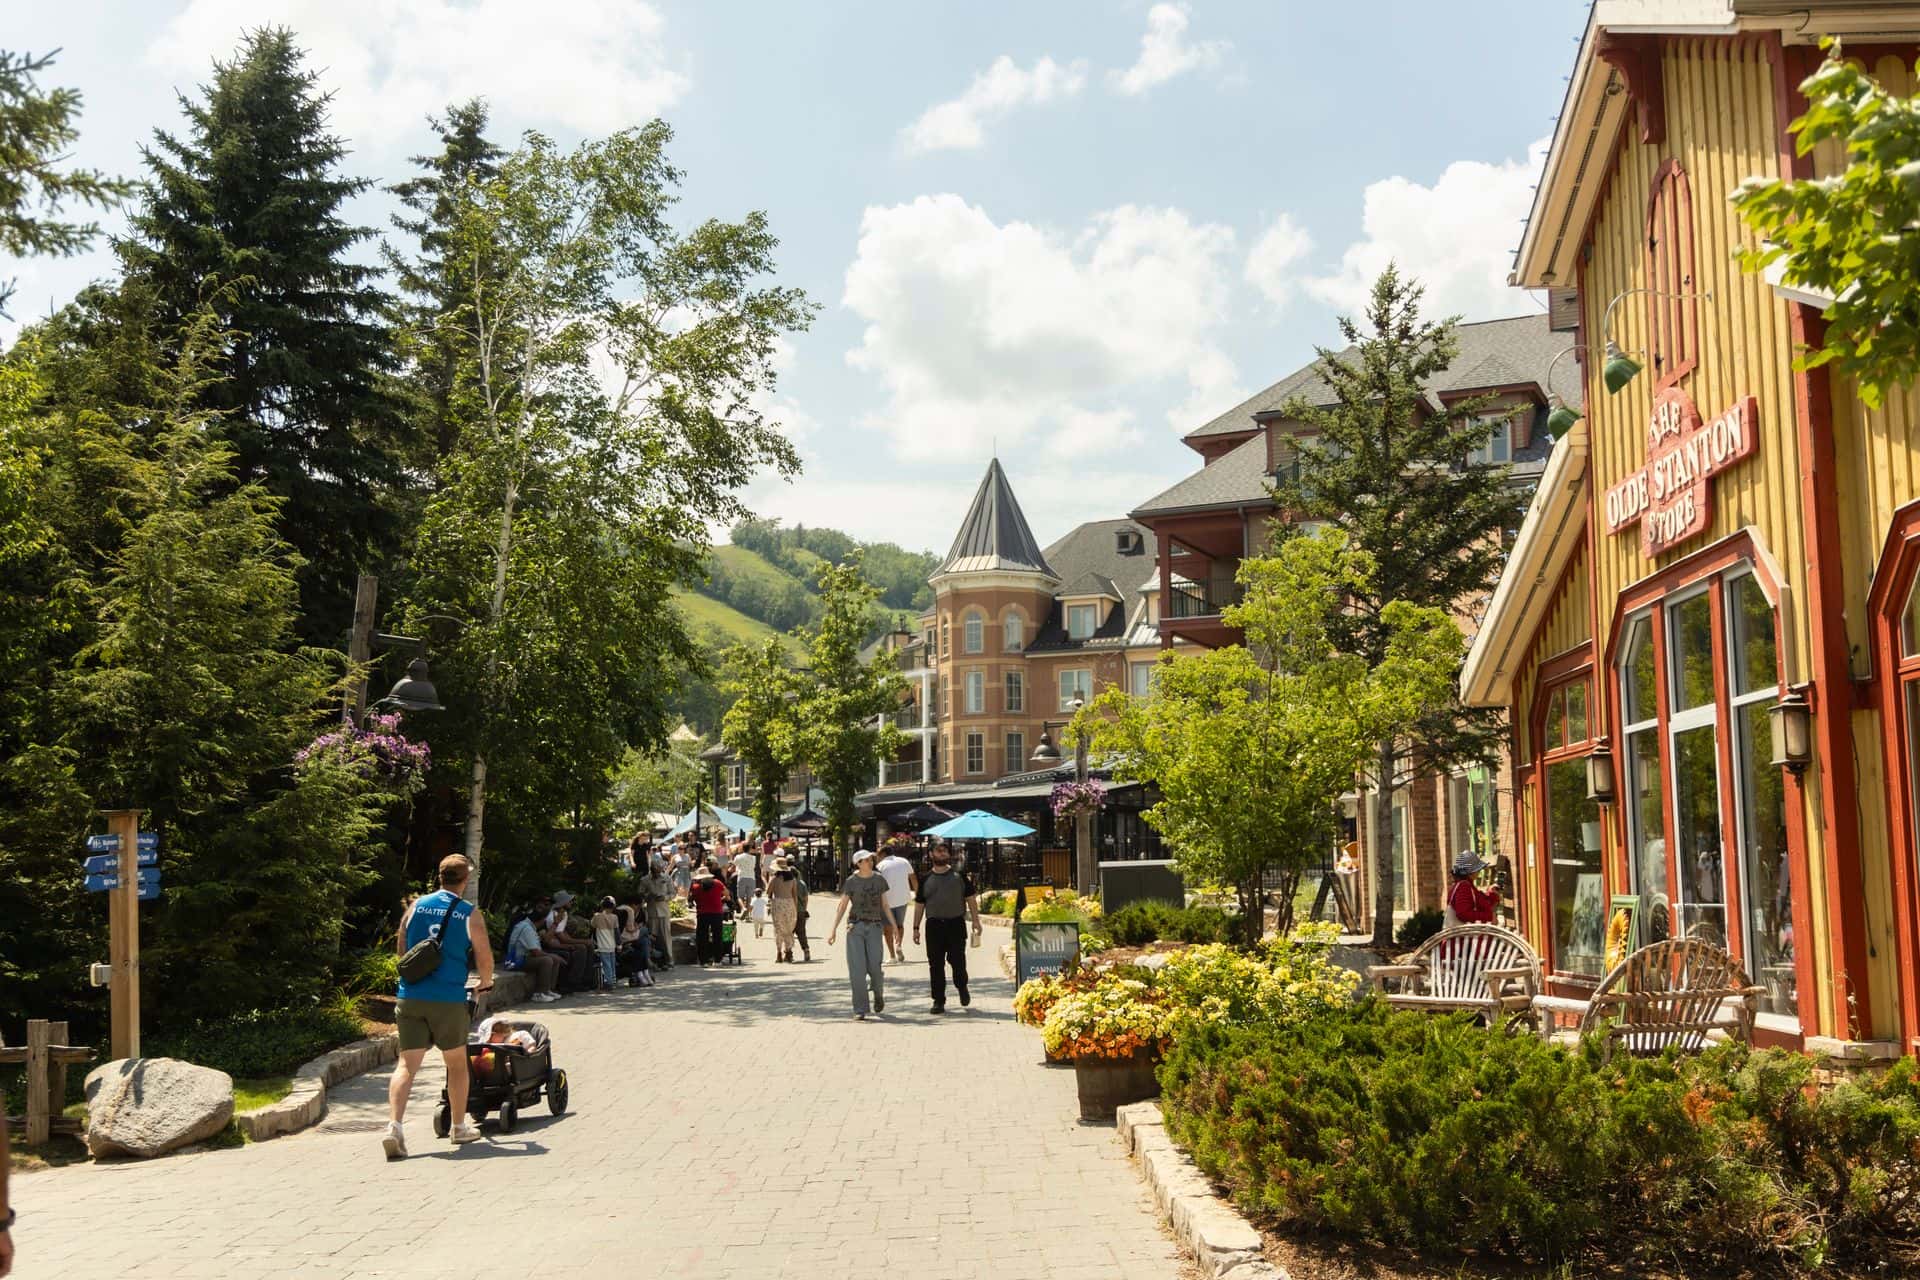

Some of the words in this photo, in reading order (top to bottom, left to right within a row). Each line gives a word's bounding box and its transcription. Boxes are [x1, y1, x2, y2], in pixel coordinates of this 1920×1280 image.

[1650, 401, 1681, 445] THE
[1606, 470, 1649, 528] OLDE
[1654, 406, 1743, 500] STANTON
[1649, 487, 1695, 544] STORE
[1032, 936, 1065, 952] chill
